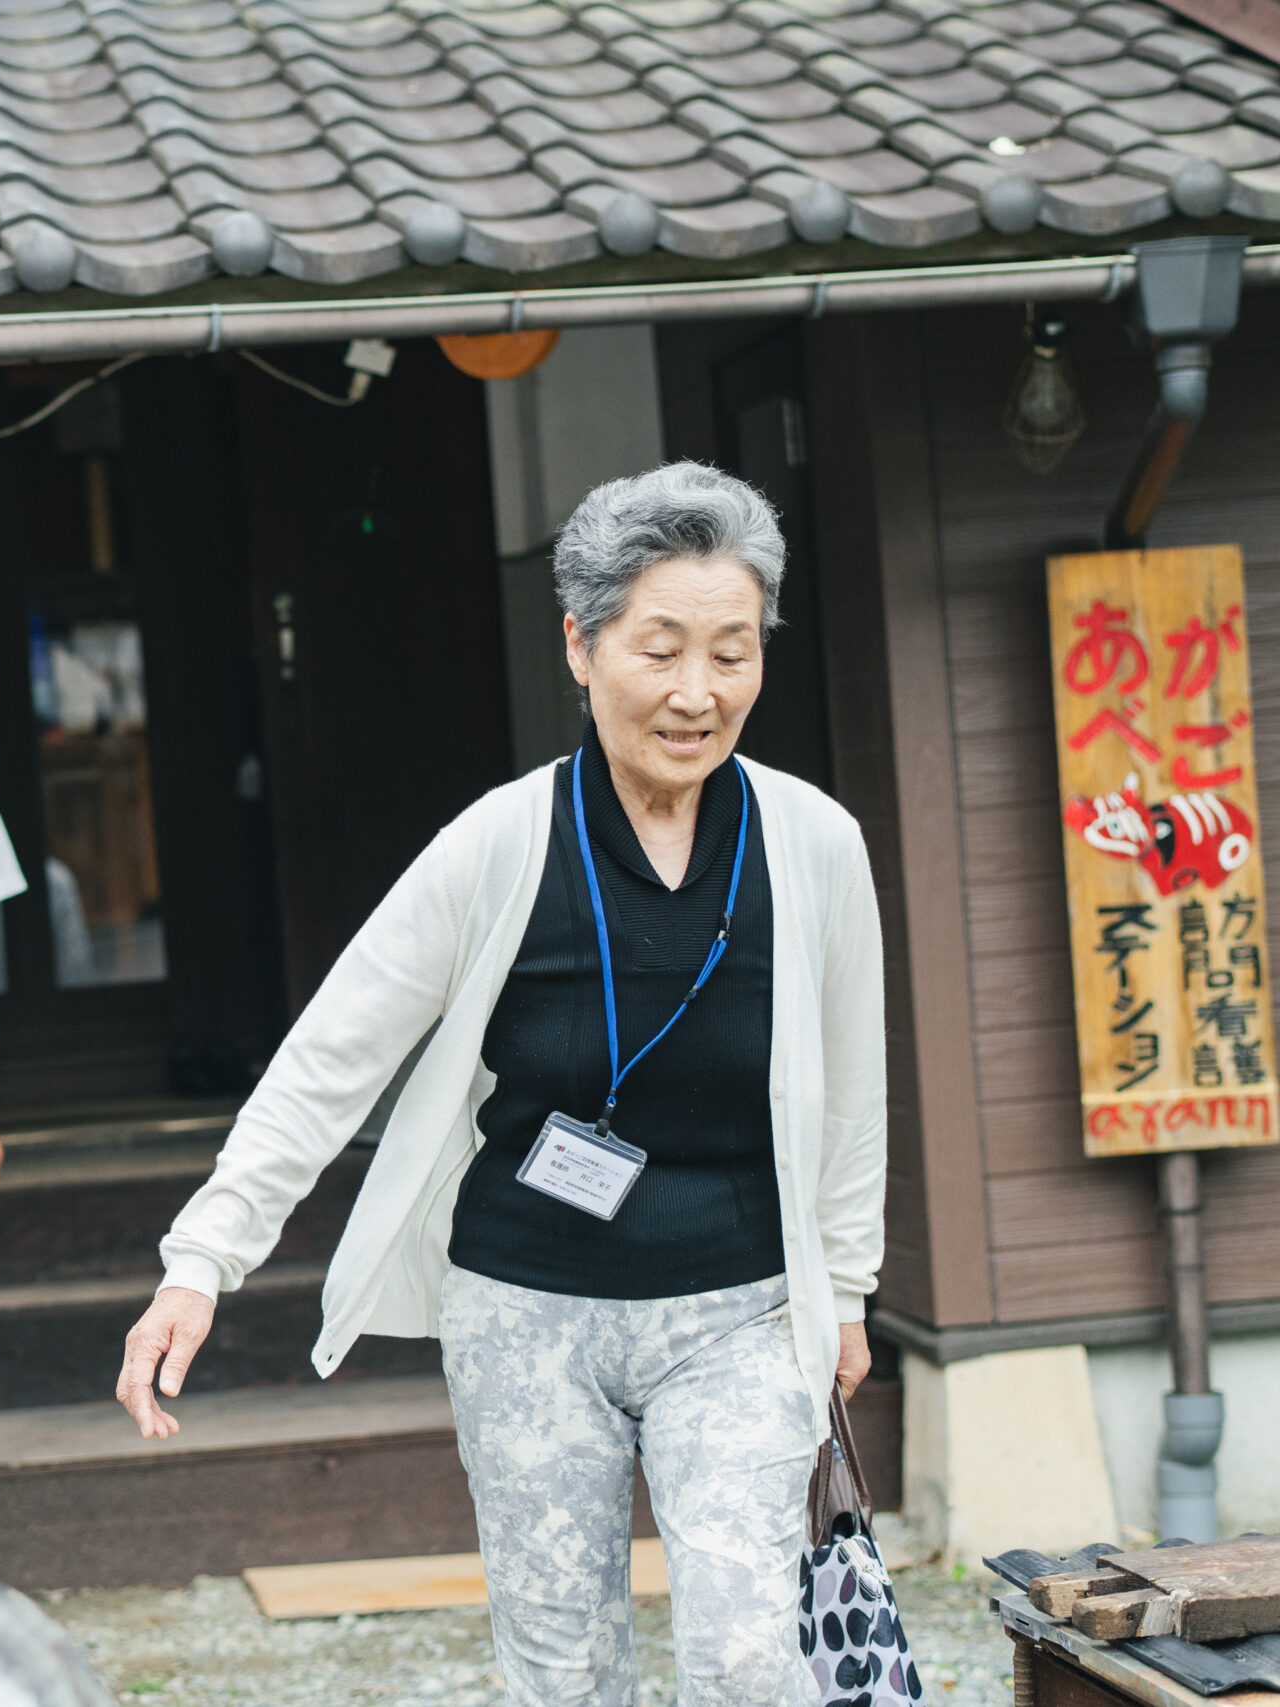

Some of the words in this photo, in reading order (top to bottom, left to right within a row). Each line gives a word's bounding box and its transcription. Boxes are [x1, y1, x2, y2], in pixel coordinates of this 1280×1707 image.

[1095, 903, 1160, 1092] ステーション
[1179, 893, 1266, 1088] 訪問看護
